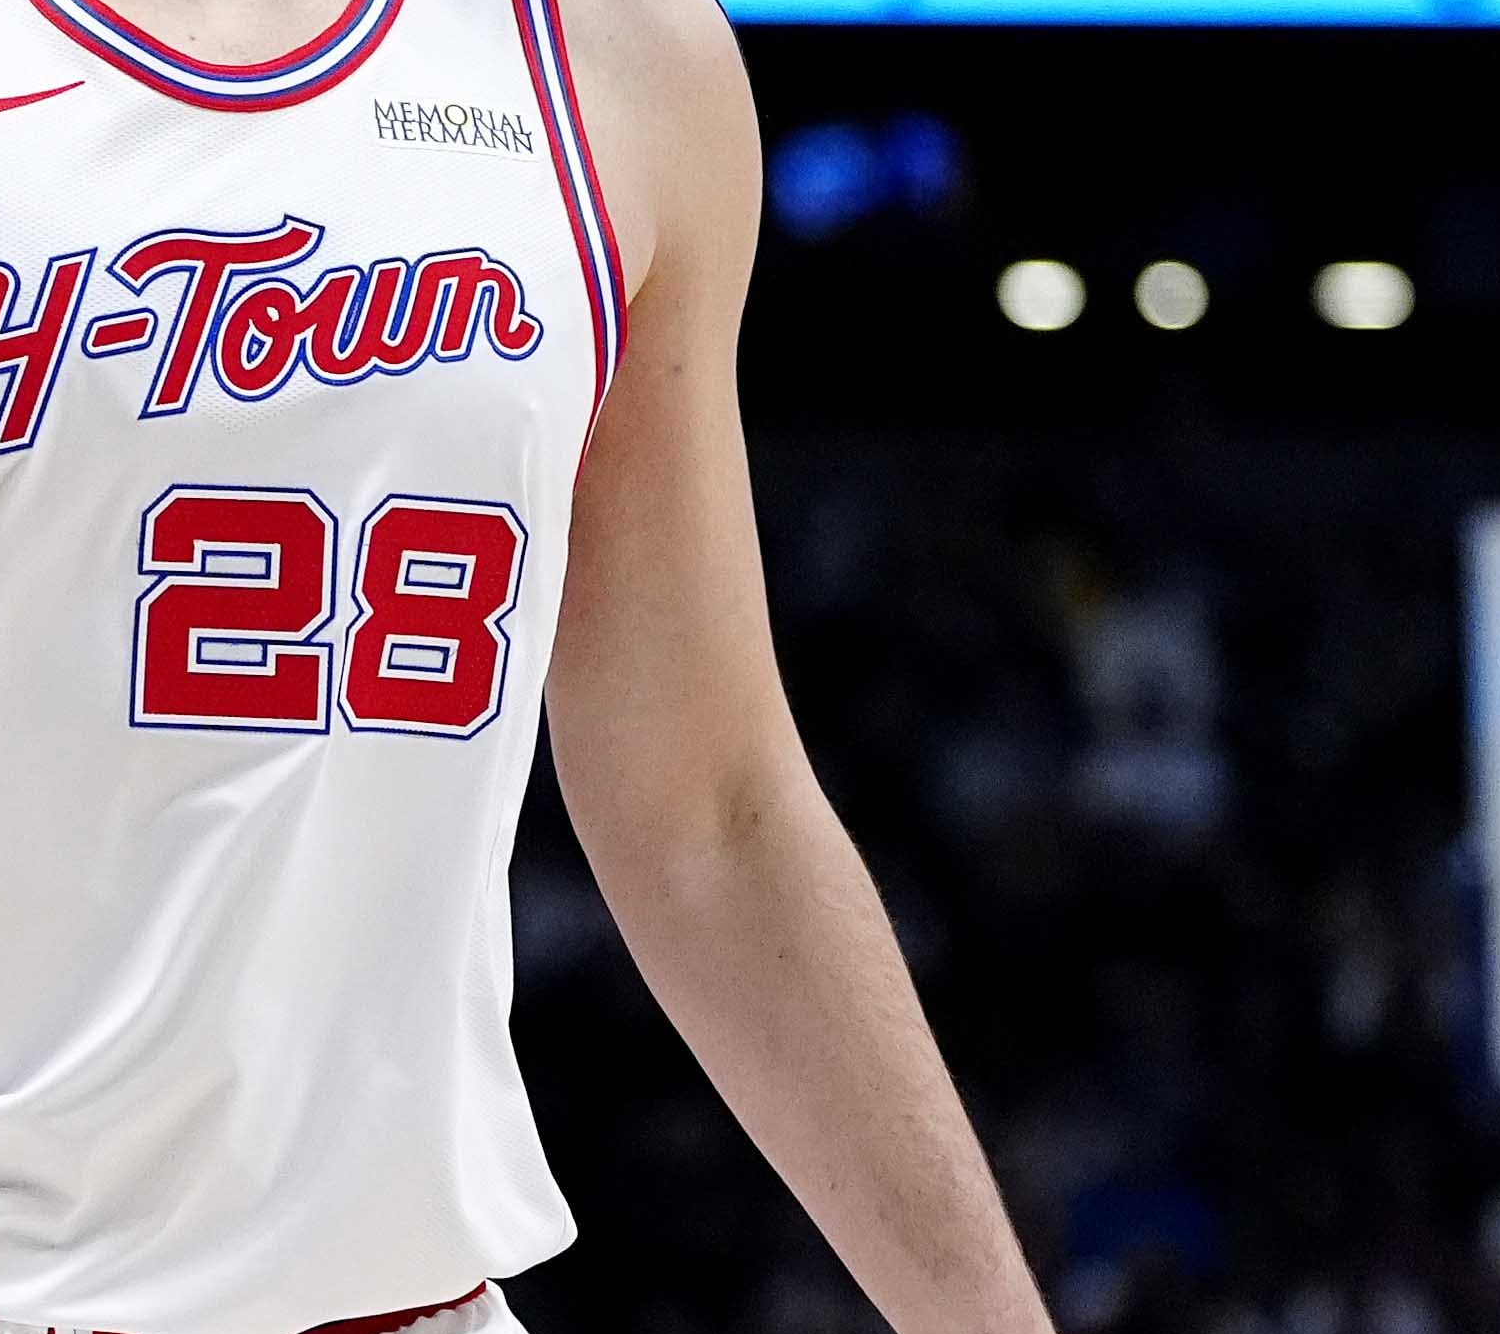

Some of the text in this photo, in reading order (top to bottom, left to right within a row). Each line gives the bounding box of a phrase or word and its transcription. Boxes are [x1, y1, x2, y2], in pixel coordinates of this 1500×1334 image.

[374, 99, 532, 136] MEMORIAL
[377, 118, 534, 154] HERMANN
[129, 484, 528, 739] 28
